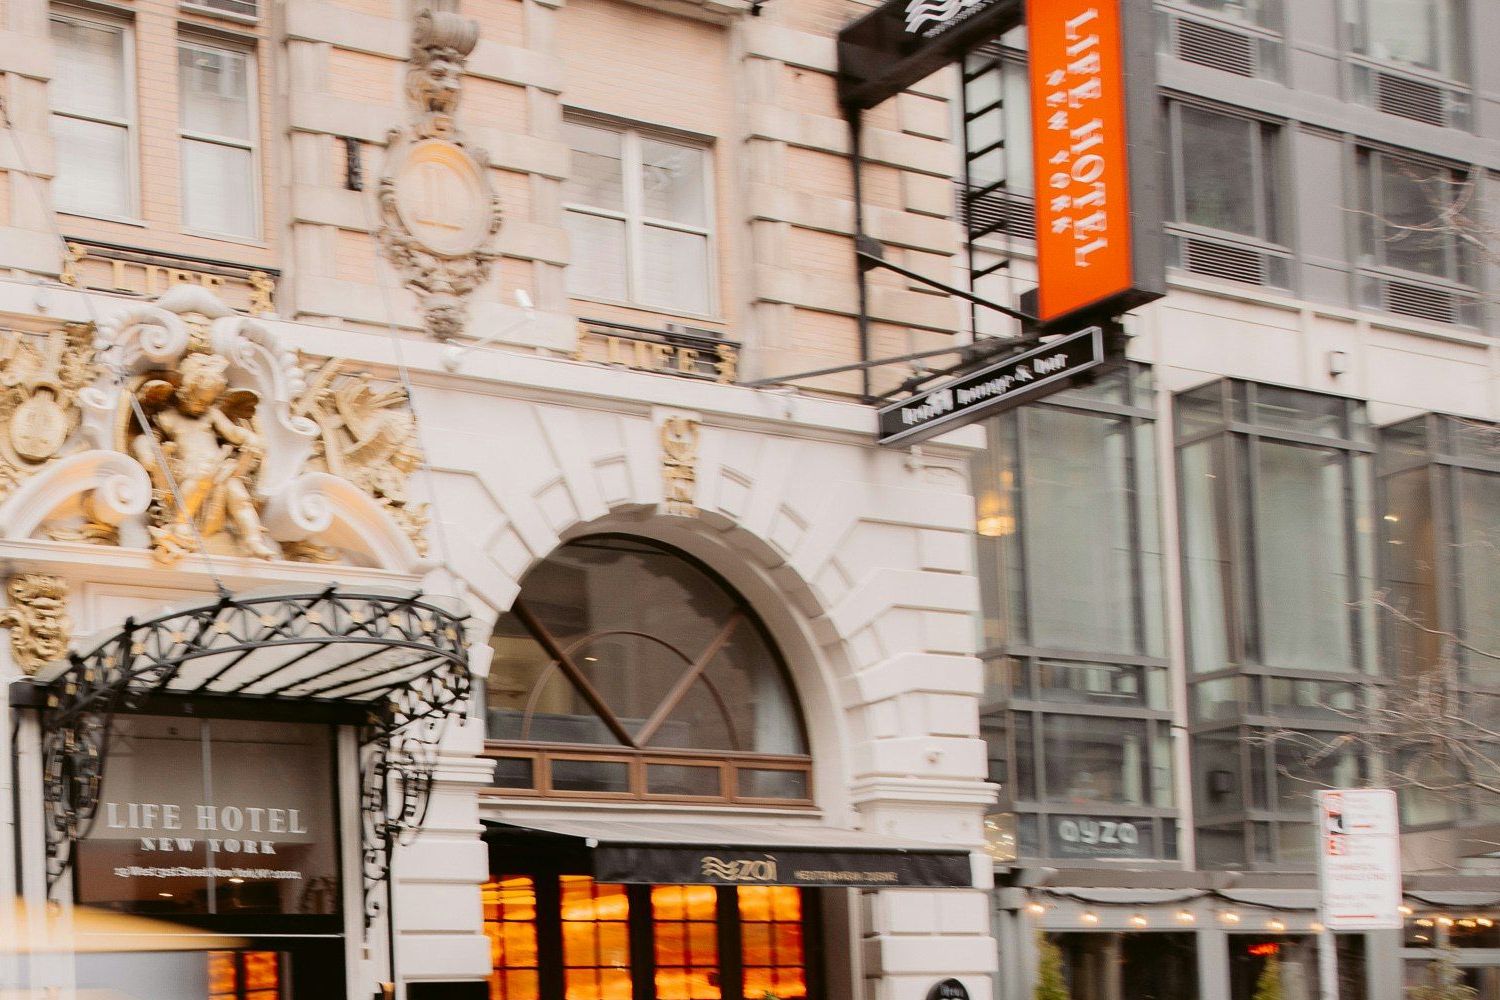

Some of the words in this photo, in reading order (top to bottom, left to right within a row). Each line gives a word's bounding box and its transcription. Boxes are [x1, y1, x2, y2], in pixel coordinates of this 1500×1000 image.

[1065, 8, 1101, 109] LIFE
[1045, 68, 1068, 131] NEW
[1049, 150, 1073, 234] YORK
[1069, 118, 1108, 267] HOTEL
[608, 336, 700, 373] LIFE
[1015, 364, 1034, 382] &
[1033, 353, 1068, 375] bar
[106, 802, 182, 830] LIFE
[196, 804, 308, 834] HOTEL
[1059, 820, 1139, 845] ayza
[140, 837, 195, 852] NEW
[207, 838, 277, 855] YORK
